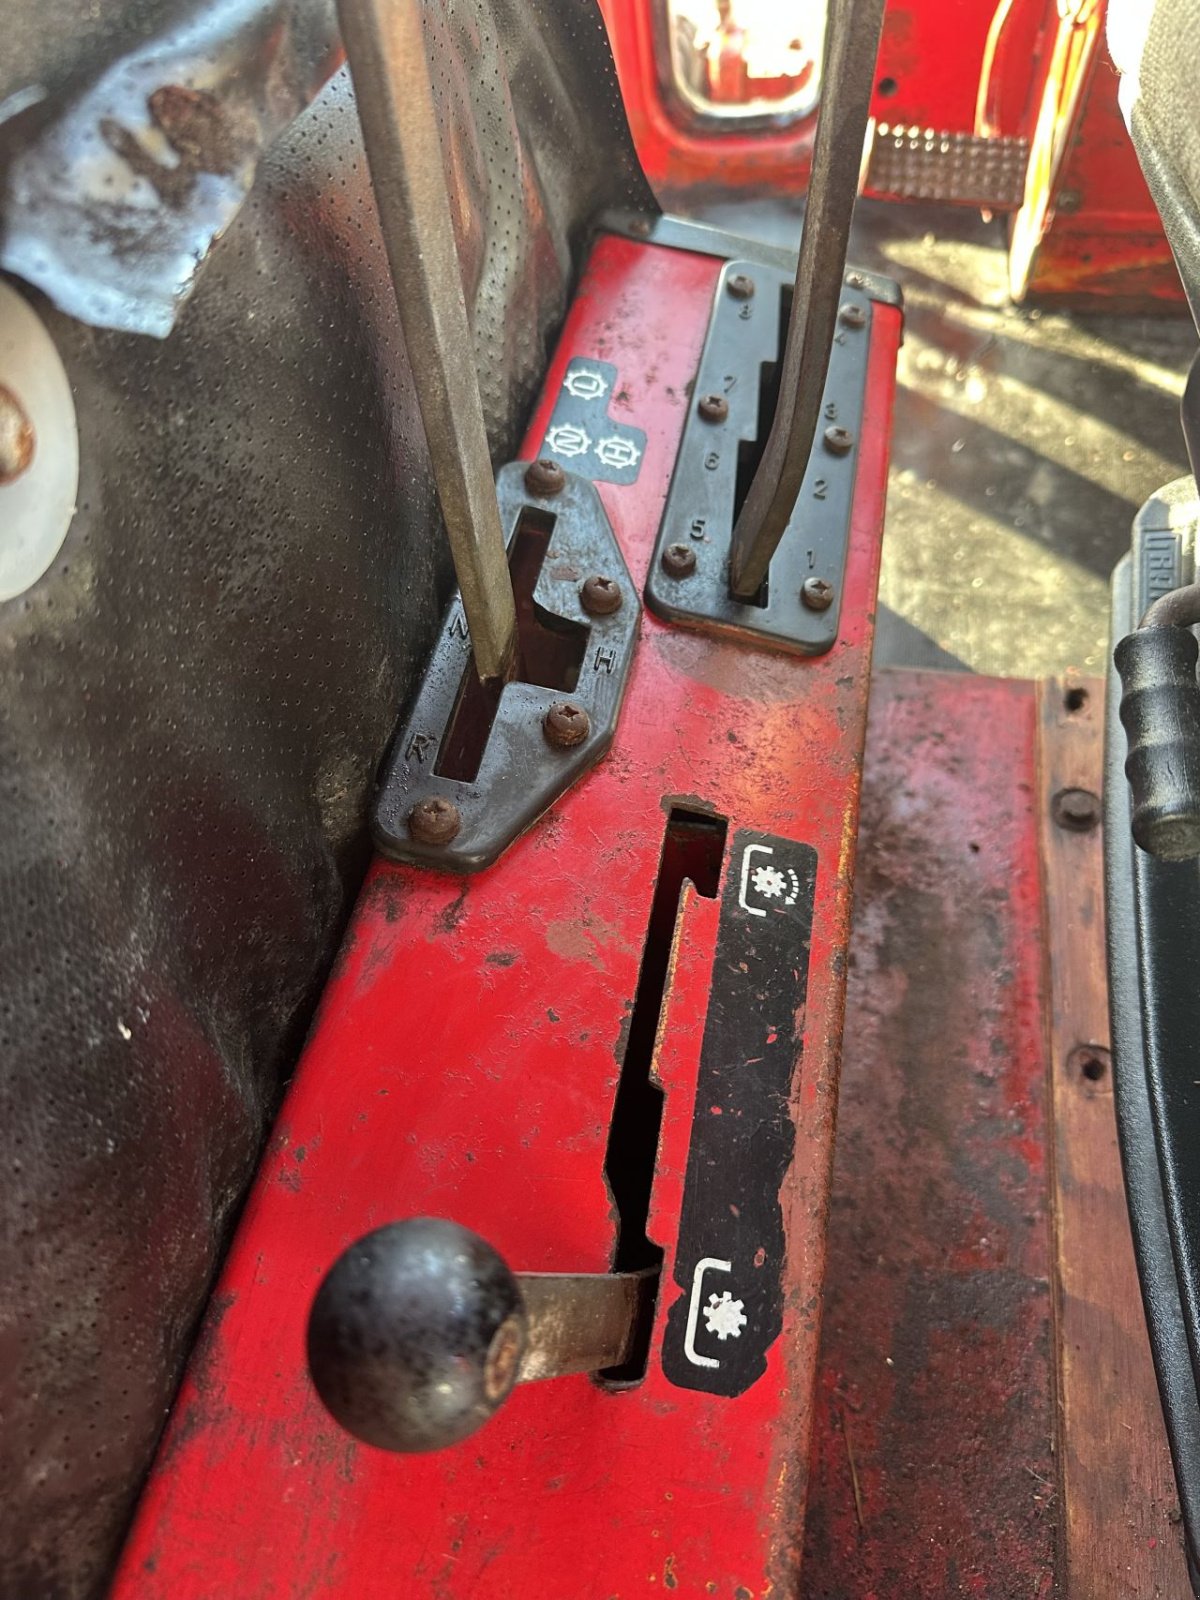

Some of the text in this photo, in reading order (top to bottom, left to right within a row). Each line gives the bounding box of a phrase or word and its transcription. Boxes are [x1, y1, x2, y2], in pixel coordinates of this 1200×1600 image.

[704, 451, 721, 471] 6
[812, 479, 828, 501] 2
[689, 518, 706, 541] 5
[806, 549, 816, 570] 1
[593, 645, 617, 674] H
[404, 731, 432, 764] R
